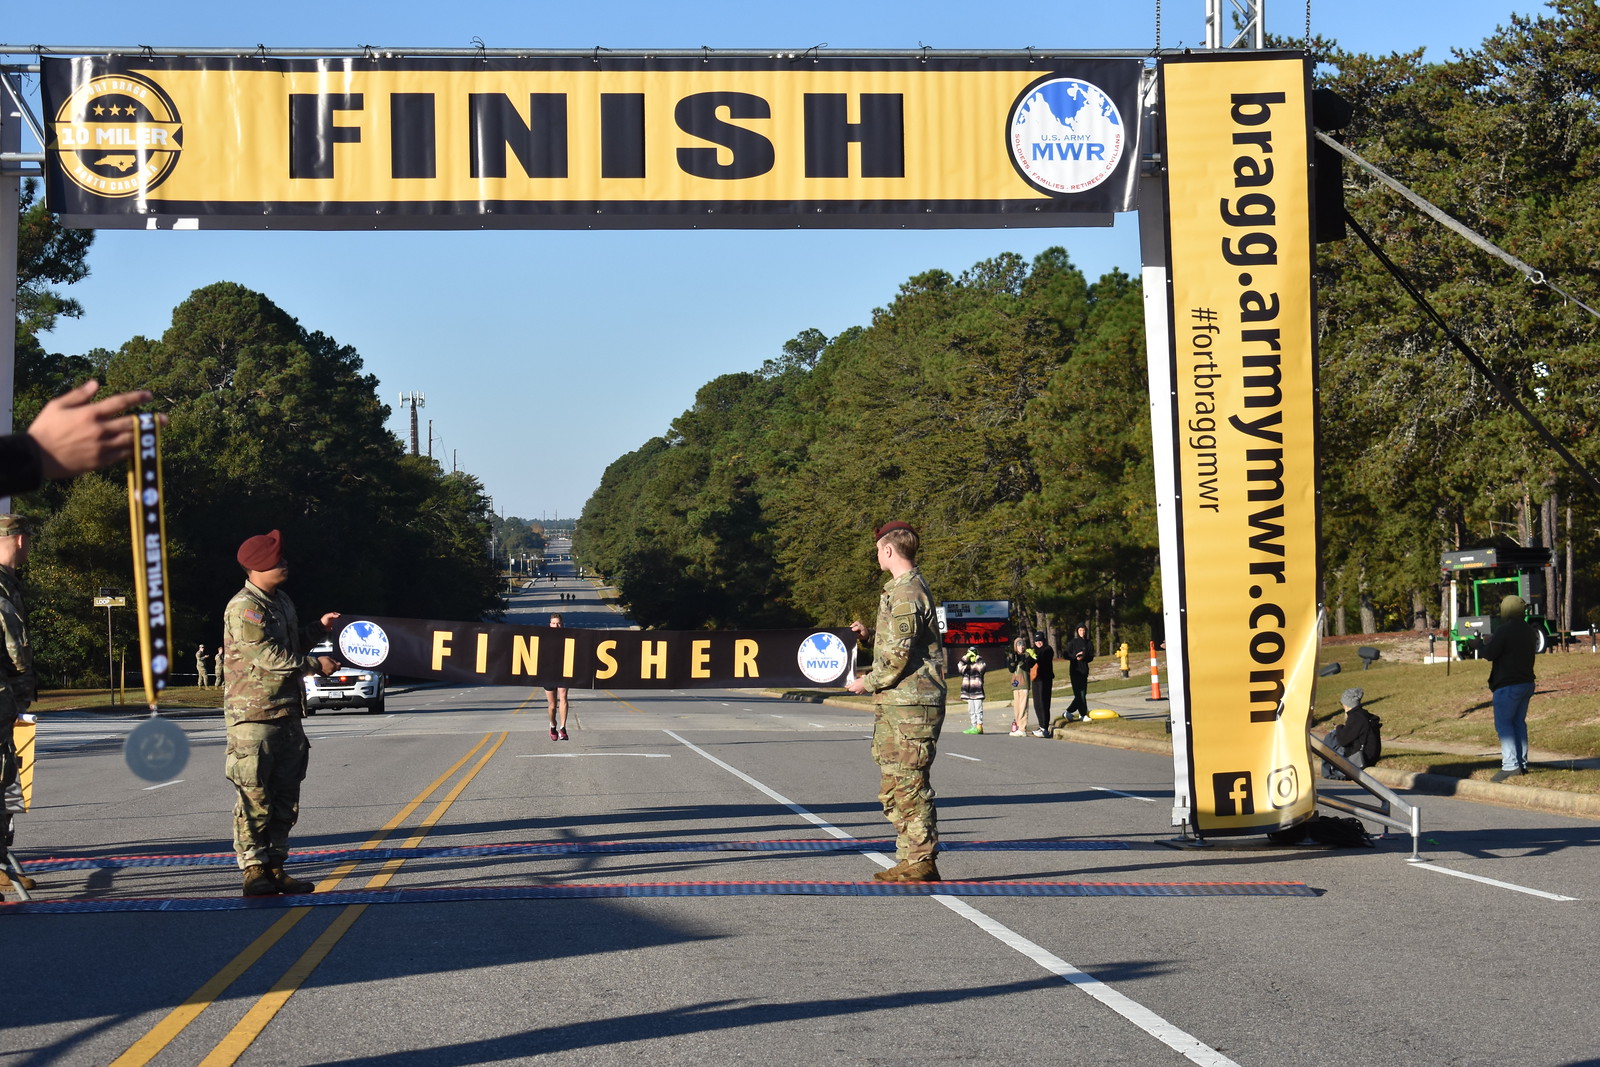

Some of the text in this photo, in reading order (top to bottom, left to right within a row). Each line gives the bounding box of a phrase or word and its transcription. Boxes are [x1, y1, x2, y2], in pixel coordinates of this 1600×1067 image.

[112, 81, 147, 98] BRAGG
[61, 127, 168, 145] 10 MILER
[288, 91, 905, 180] FINISH
[1015, 133, 1121, 190] SOLDIERS FAMILIES RETIREES CIVILIANS
[1032, 143, 1105, 160] MWR
[74, 166, 106, 189] NORTH
[1188, 307, 1222, 512] #fortbraggmwr
[1220, 92, 1287, 723] bragg.armymwr.com
[141, 434, 155, 460] 10
[146, 533, 165, 627] 10 MILER
[348, 646, 380, 656] MWR
[431, 630, 760, 681] FINISHER
[806, 660, 839, 669] MWR
